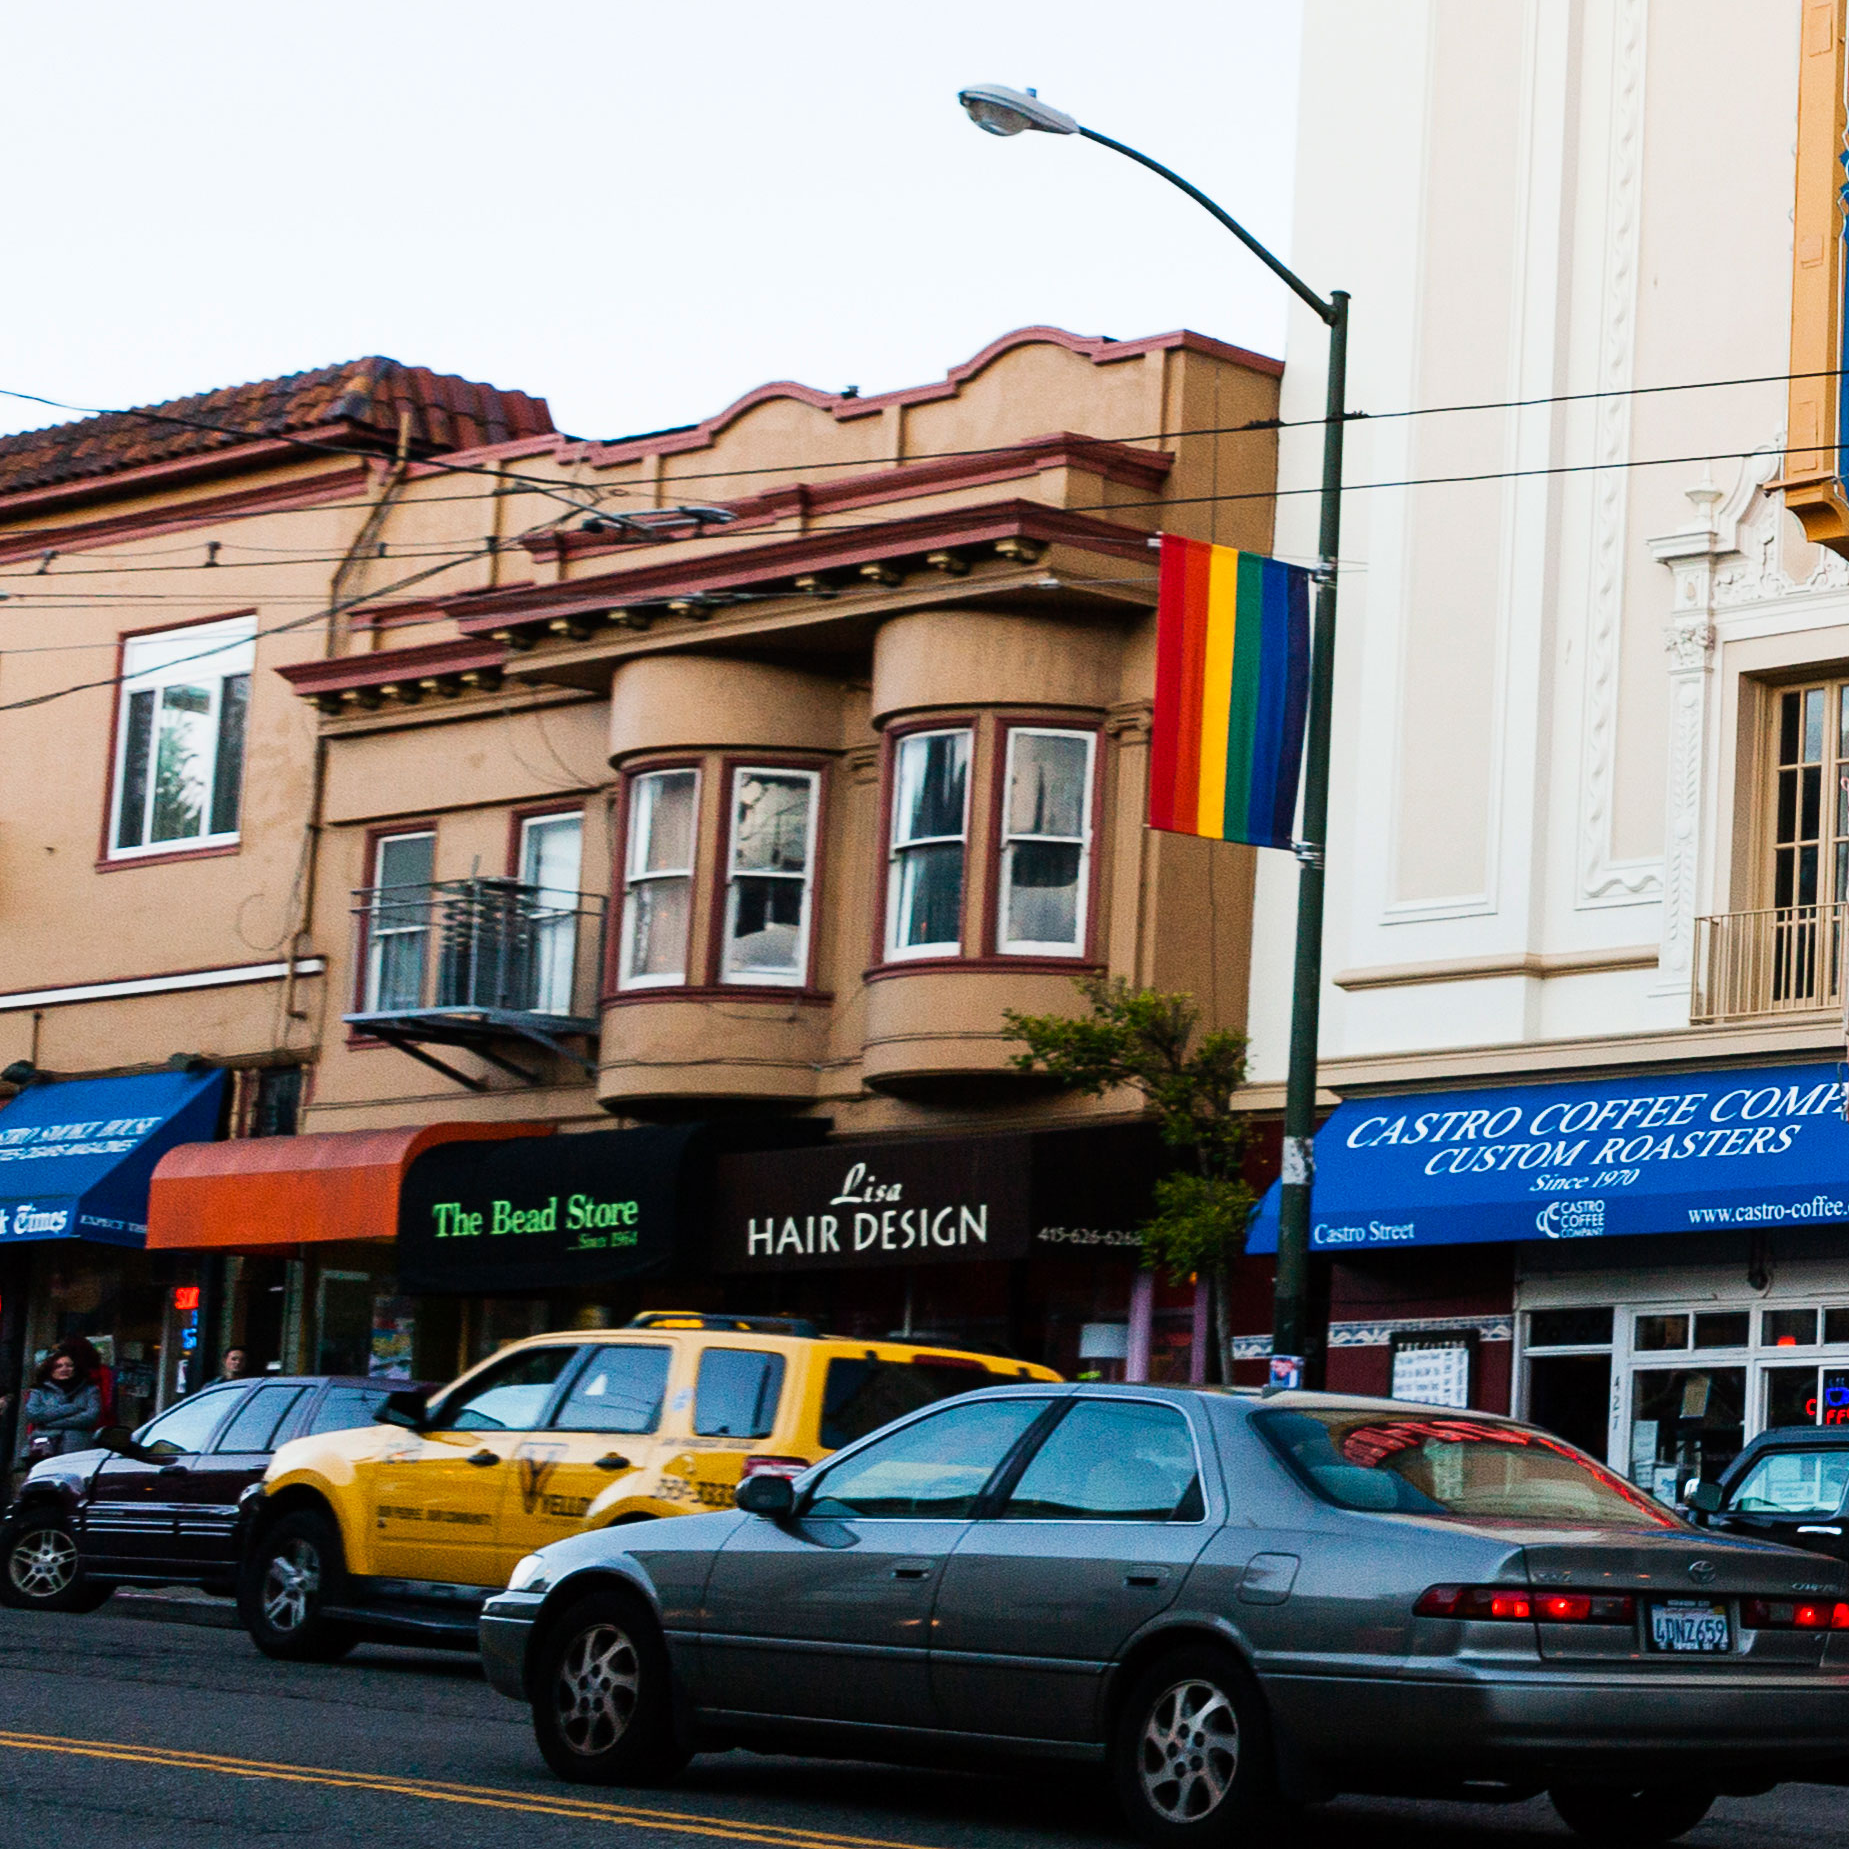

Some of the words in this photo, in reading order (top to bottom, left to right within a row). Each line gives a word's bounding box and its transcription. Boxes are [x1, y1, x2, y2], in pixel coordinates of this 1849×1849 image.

[1346, 1106, 1523, 1149] CASTRO
[1529, 1093, 1708, 1136] COFFEE
[1424, 1139, 1590, 1176] CUSTOM
[1589, 1124, 1802, 1164] ROASTERS
[829, 1162, 903, 1205] Lisa
[1529, 1173, 1589, 1191] Since
[1591, 1168, 1640, 1188] 1970
[432, 1202, 483, 1238] The
[489, 1196, 558, 1234] Bead
[565, 1194, 639, 1229] Store
[1560, 1199, 1606, 1214] CASTRO
[1560, 1213, 1606, 1228] COFFEE
[747, 1214, 841, 1256] HAIR
[854, 1204, 988, 1251] DESIGN
[1314, 1223, 1366, 1244] Castro
[1369, 1220, 1415, 1241] Street
[1560, 1227, 1605, 1239] COMPANY
